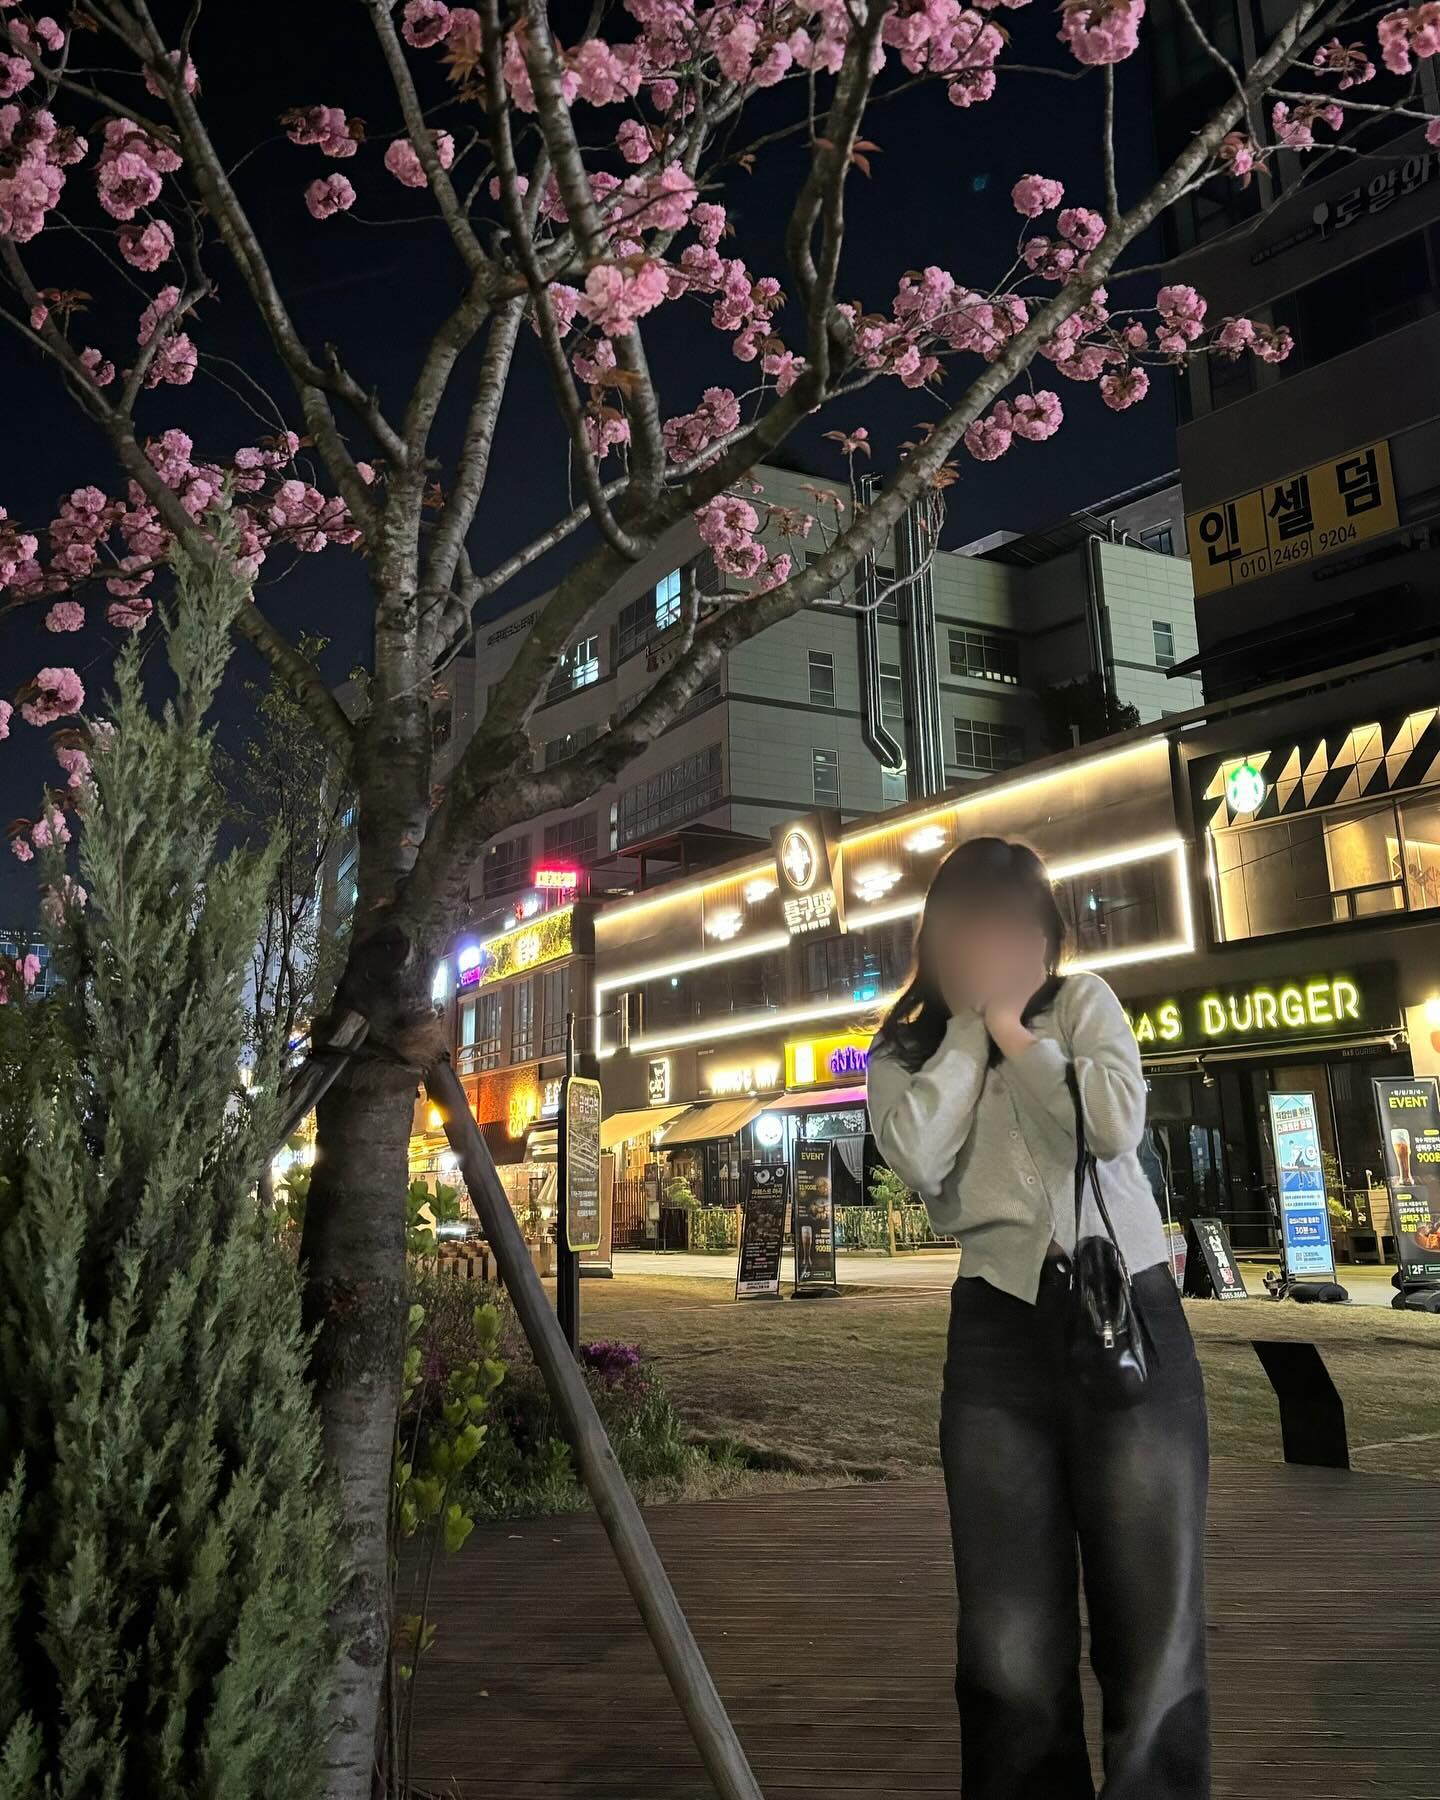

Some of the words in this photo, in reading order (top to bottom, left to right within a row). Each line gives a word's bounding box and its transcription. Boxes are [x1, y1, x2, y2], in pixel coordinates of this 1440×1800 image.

[1240, 555, 1267, 578] 010
[1274, 540, 1309, 566] 2469
[1319, 523, 1357, 551] 9204
[1127, 1002, 1182, 1041] AS
[1203, 981, 1359, 1035] BURGER
[1389, 1096, 1428, 1109] EVENT
[801, 1152, 825, 1161] EVENT
[1411, 1264, 1424, 1275] 2F
